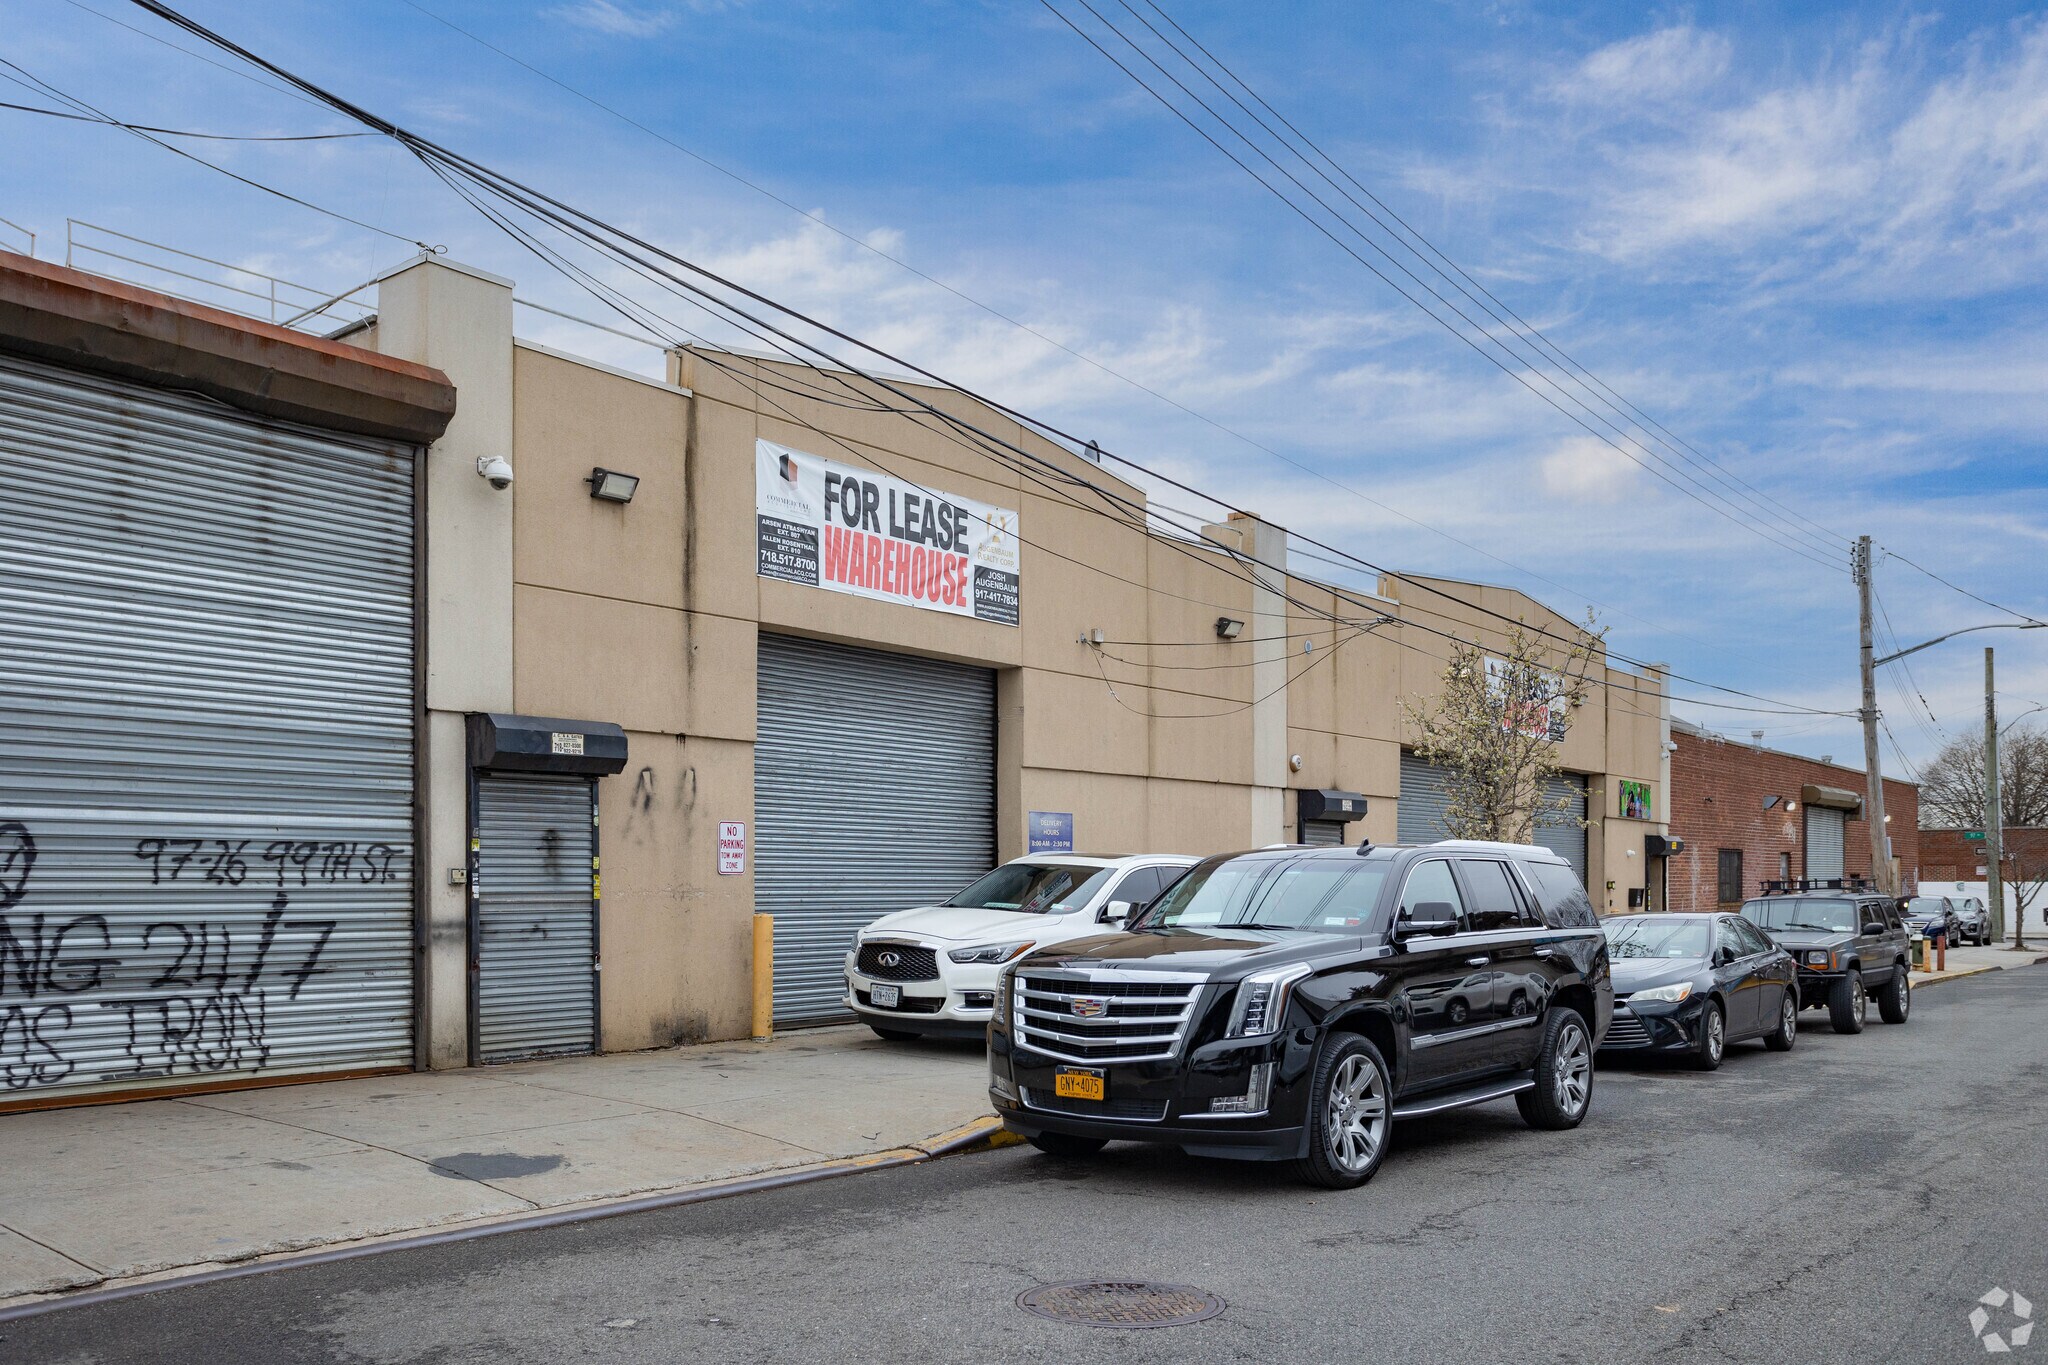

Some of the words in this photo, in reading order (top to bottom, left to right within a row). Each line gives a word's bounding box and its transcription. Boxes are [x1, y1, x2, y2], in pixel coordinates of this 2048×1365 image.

[824, 470, 881, 534] FOR
[889, 488, 969, 554] LEASE
[761, 518, 781, 528] ARSEN
[777, 528, 789, 537] EXT.
[762, 534, 781, 544] ALLEN
[781, 538, 815, 552] ROSENTHAL
[777, 544, 789, 553] EXT.
[760, 550, 816, 571] 718.517.8700
[824, 524, 968, 608] WAREHOUSE
[760, 562, 817, 579] COMMERCIALACQ.COM
[988, 571, 1006, 582] JOSH
[975, 577, 1018, 594] AUGENBAUM
[975, 588, 1018, 607] 917-417-7834
[726, 826, 738, 837] NO
[1040, 819, 1063, 827] DELIVERY
[720, 839, 744, 850] PARKING
[134, 838, 248, 886] 97-26
[725, 861, 738, 869] ZONE
[142, 888, 337, 1001] 24/7
